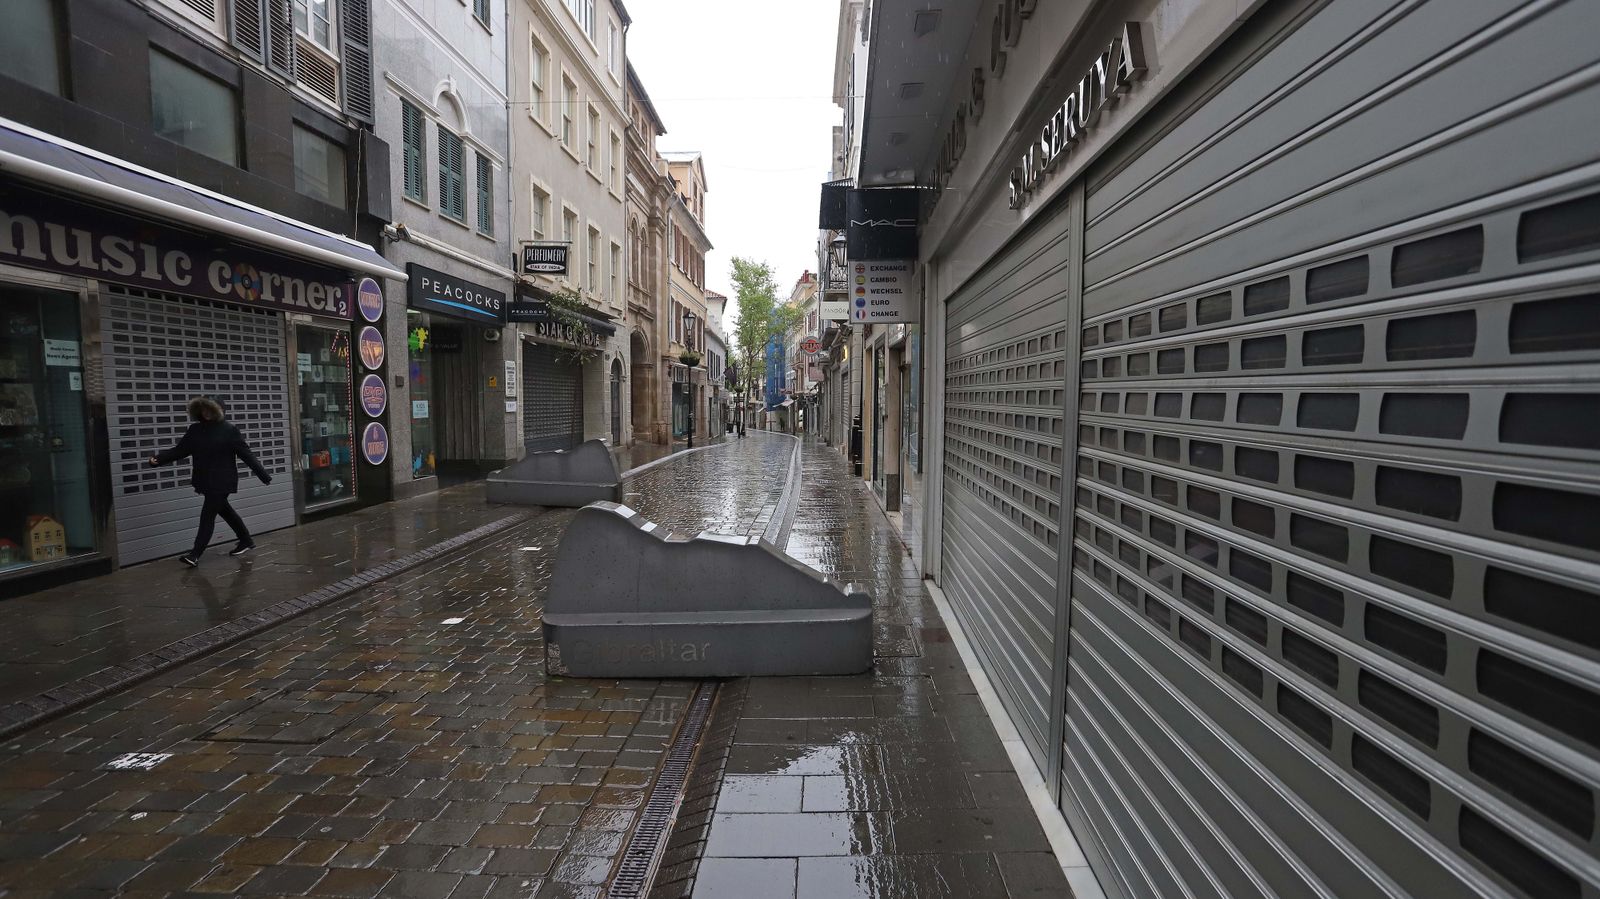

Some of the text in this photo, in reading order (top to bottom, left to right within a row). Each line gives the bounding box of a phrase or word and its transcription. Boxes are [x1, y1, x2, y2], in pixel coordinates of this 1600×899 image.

[1040, 23, 1145, 170] SERUYA
[526, 248, 566, 262] PERFUMERY
[208, 260, 341, 312] corner
[338, 300, 347, 316] 2
[421, 276, 500, 311] PEACOCKS
[364, 386, 384, 399] DVD
[572, 639, 711, 664] Gibraltar
